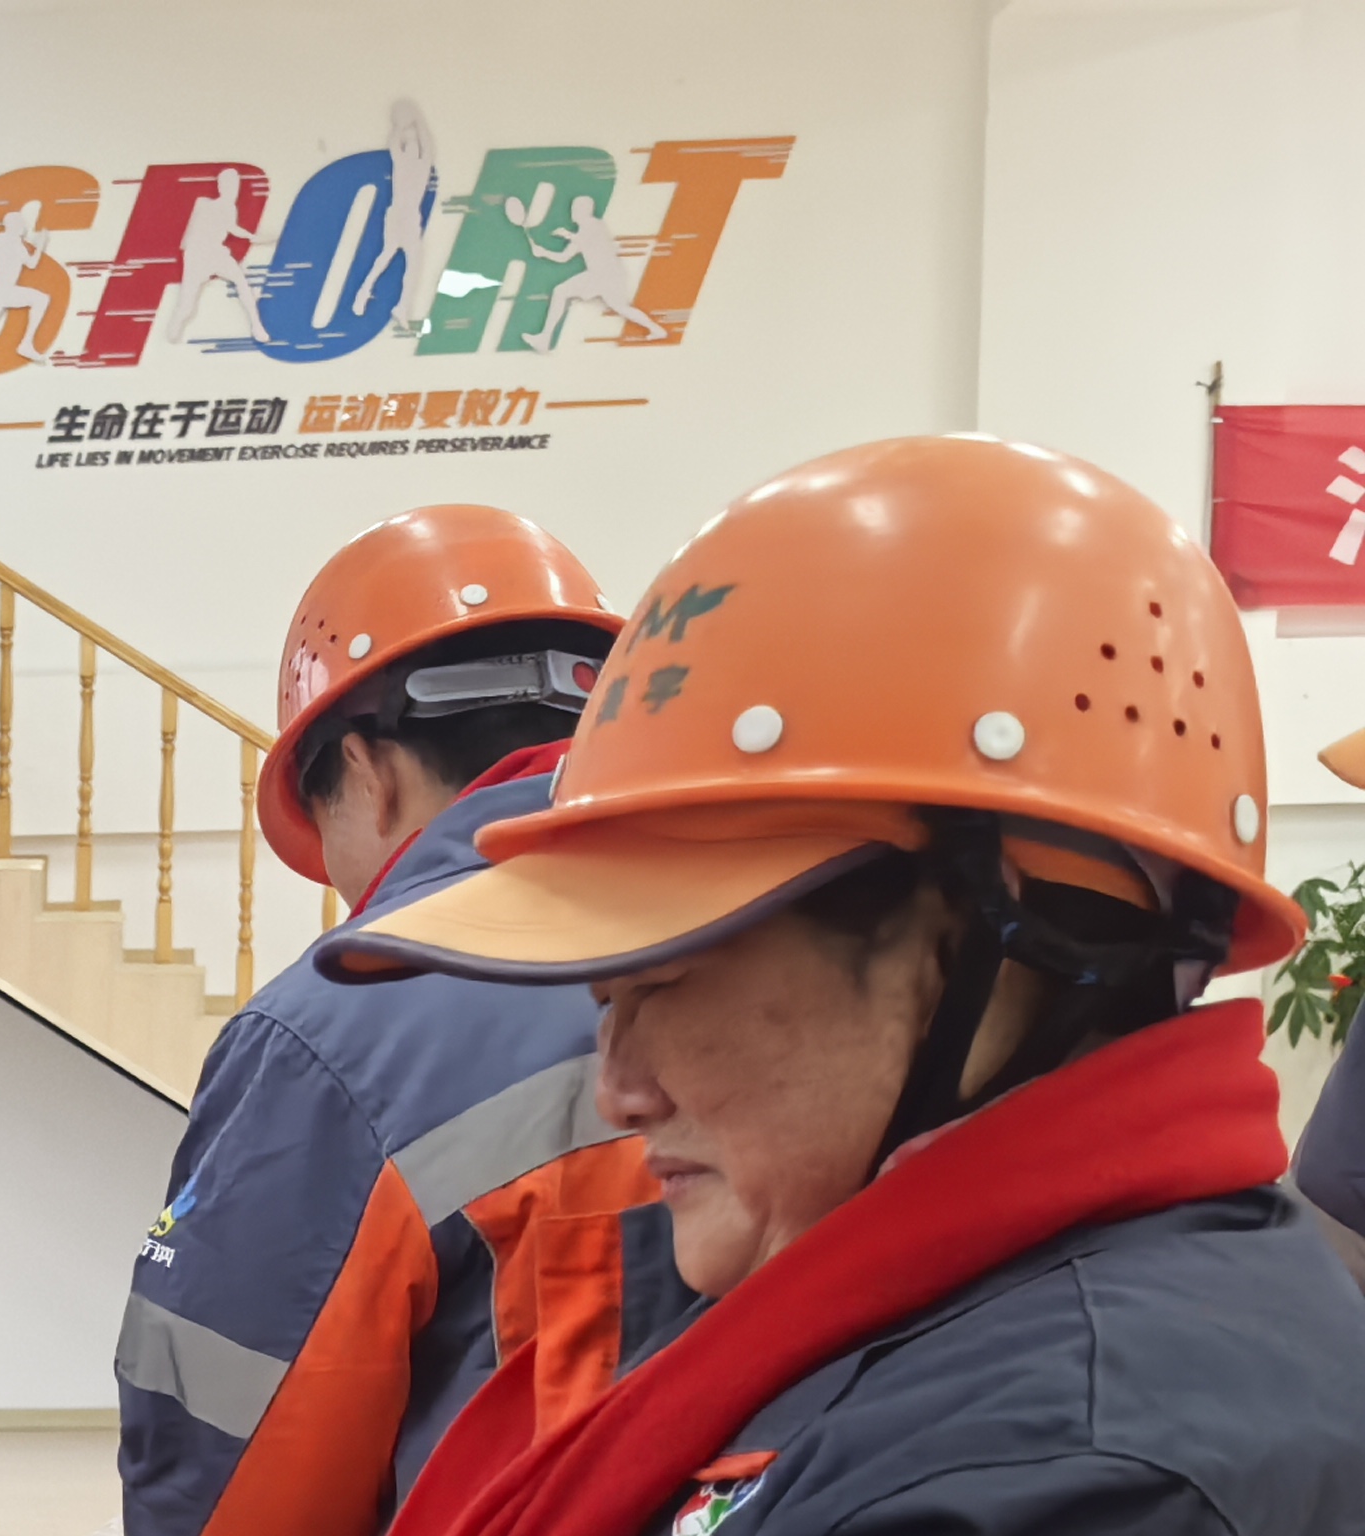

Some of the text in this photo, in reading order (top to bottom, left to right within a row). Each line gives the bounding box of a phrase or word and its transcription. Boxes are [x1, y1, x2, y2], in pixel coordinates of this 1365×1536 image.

[47, 396, 287, 443] 生命在于运动
[36, 453, 69, 468] LIFE
[75, 451, 110, 467] LIES
[136, 446, 234, 465] MOVEMENT
[323, 439, 409, 458] REQUIRES
[413, 434, 550, 454] PERSEVERANCE
